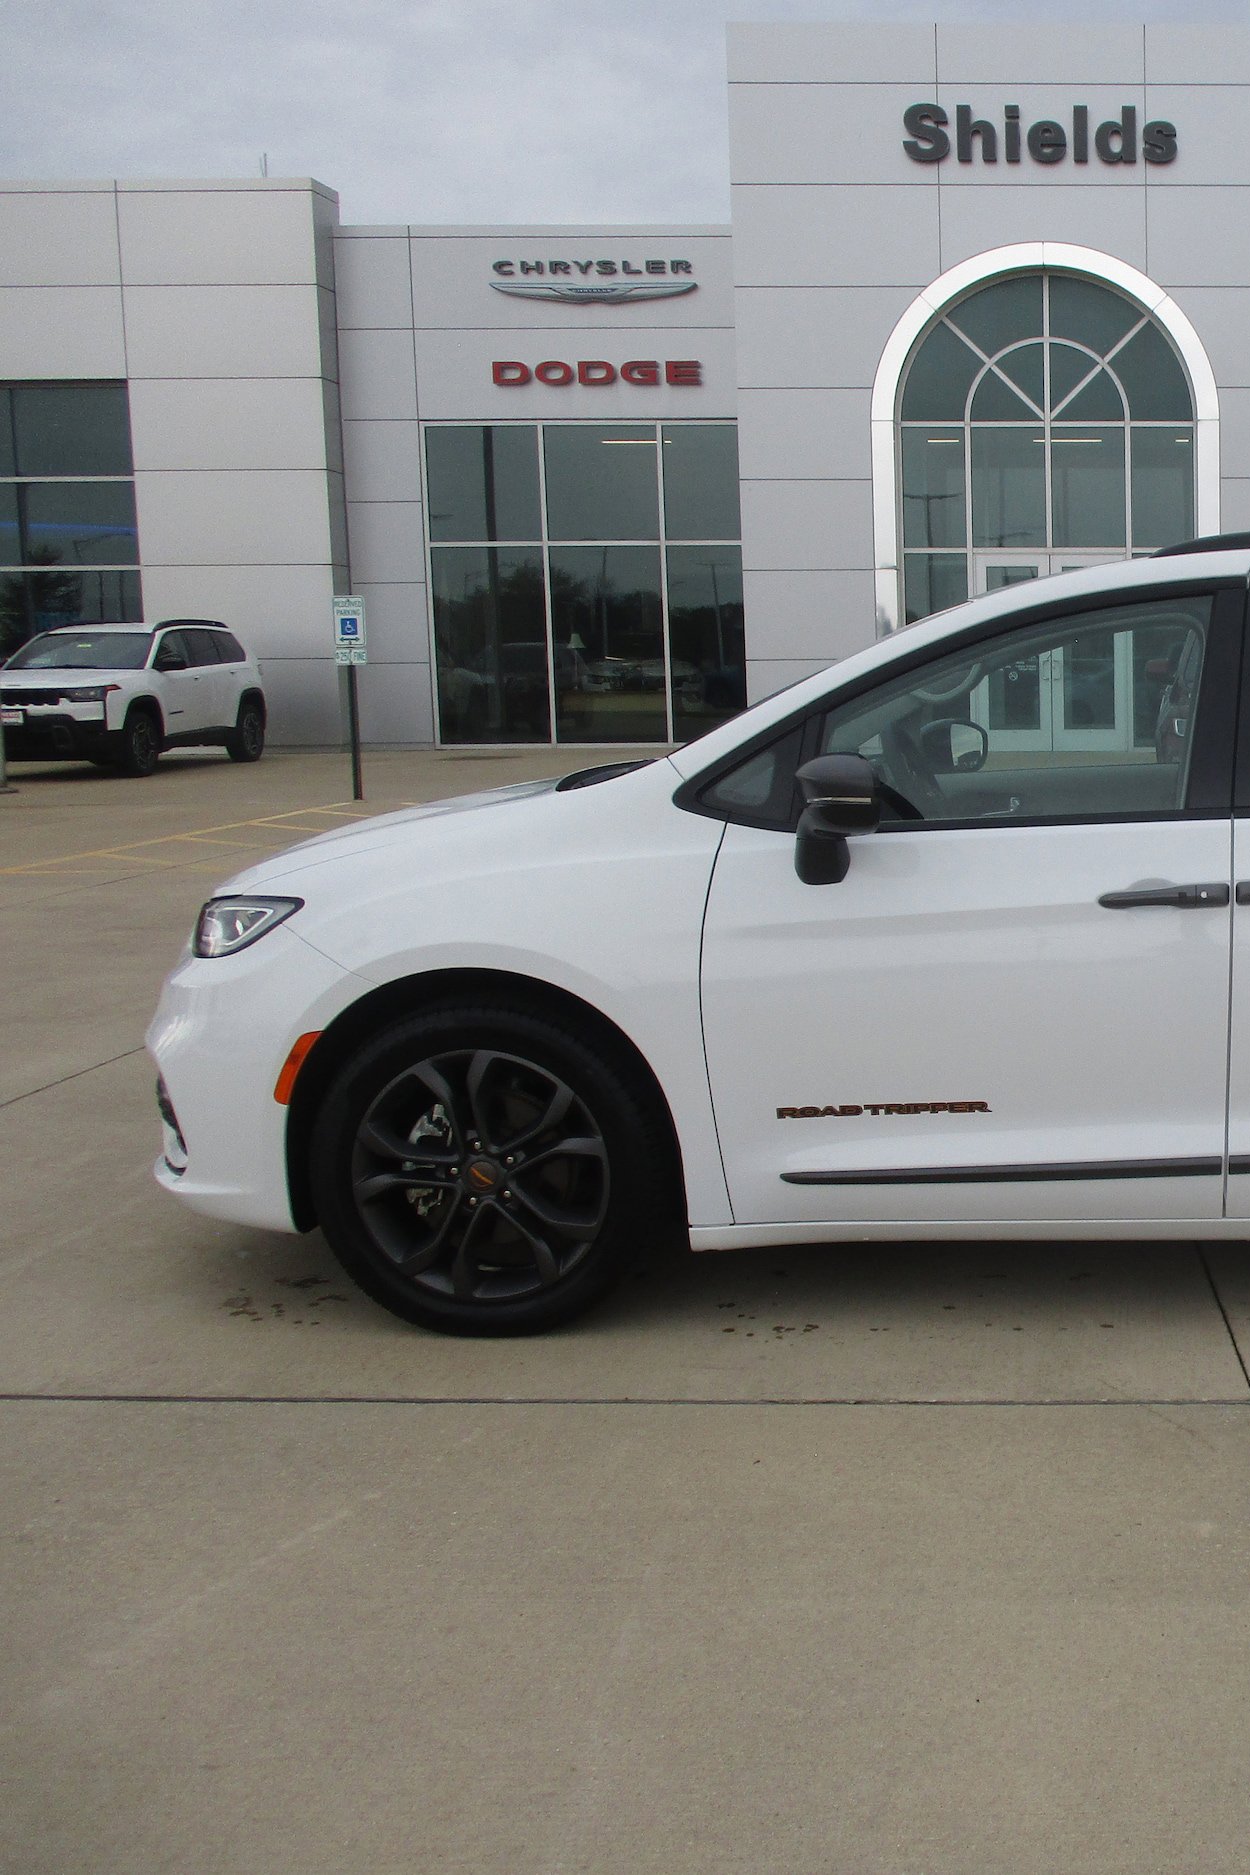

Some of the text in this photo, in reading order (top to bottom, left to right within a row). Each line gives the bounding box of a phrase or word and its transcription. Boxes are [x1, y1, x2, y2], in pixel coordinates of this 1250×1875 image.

[903, 103, 1178, 163] Shields
[492, 259, 693, 276] CHRYSLER
[492, 360, 702, 386] DODGE
[354, 651, 366, 662] FINE
[776, 1101, 992, 1119] ROAD TRIPPER
